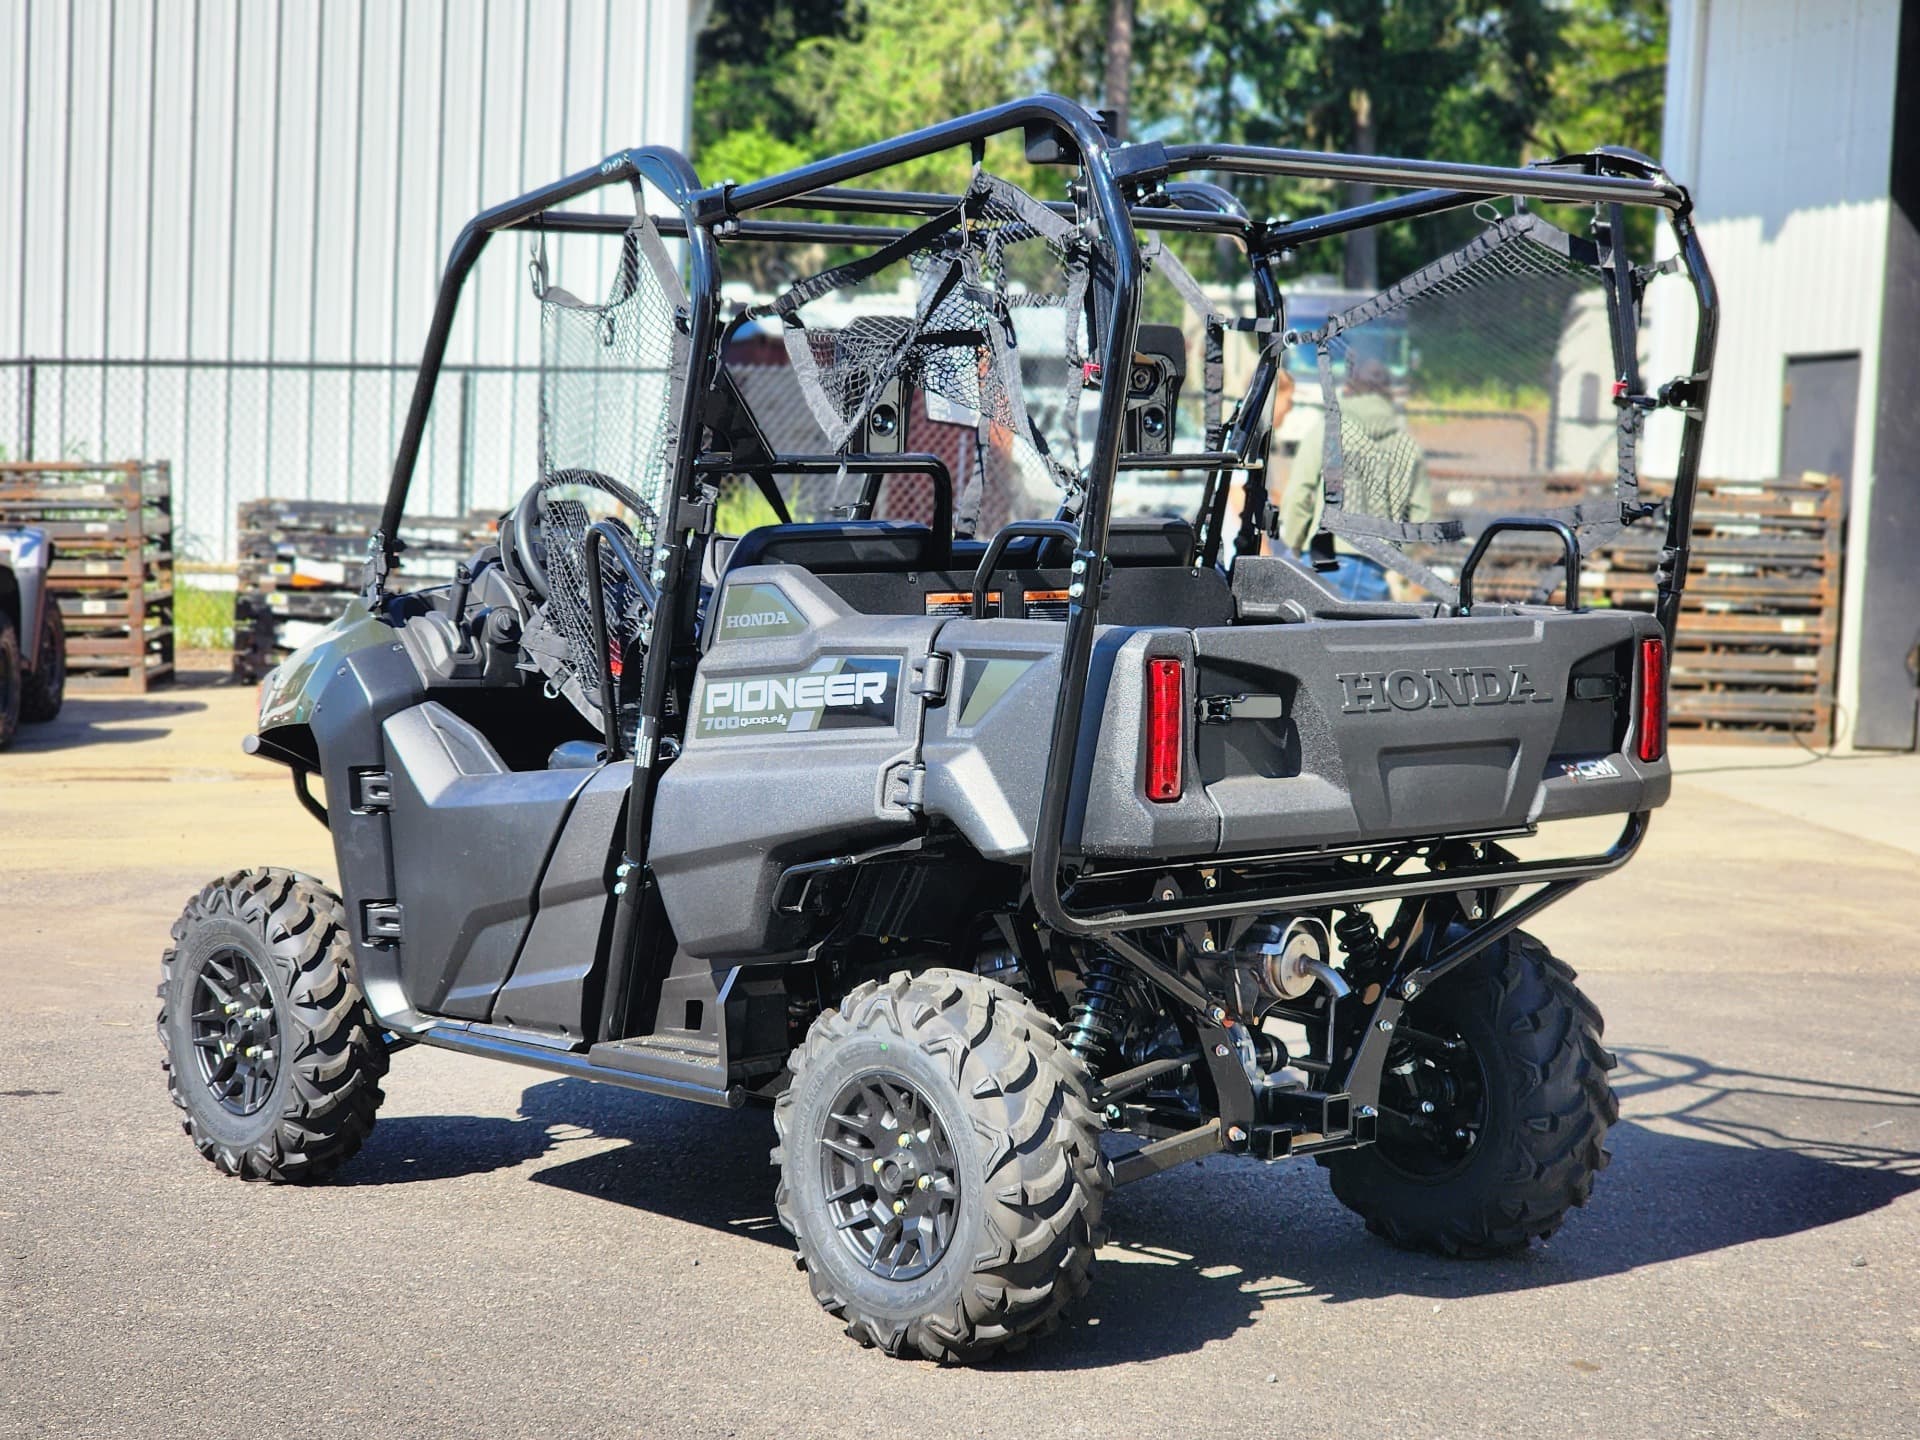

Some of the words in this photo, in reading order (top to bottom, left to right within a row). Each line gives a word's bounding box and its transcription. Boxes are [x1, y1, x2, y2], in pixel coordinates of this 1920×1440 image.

[727, 611, 789, 628] HONDA
[706, 672, 887, 714] PIONEER
[1336, 665, 1552, 713] HONDA
[702, 716, 739, 730] 700
